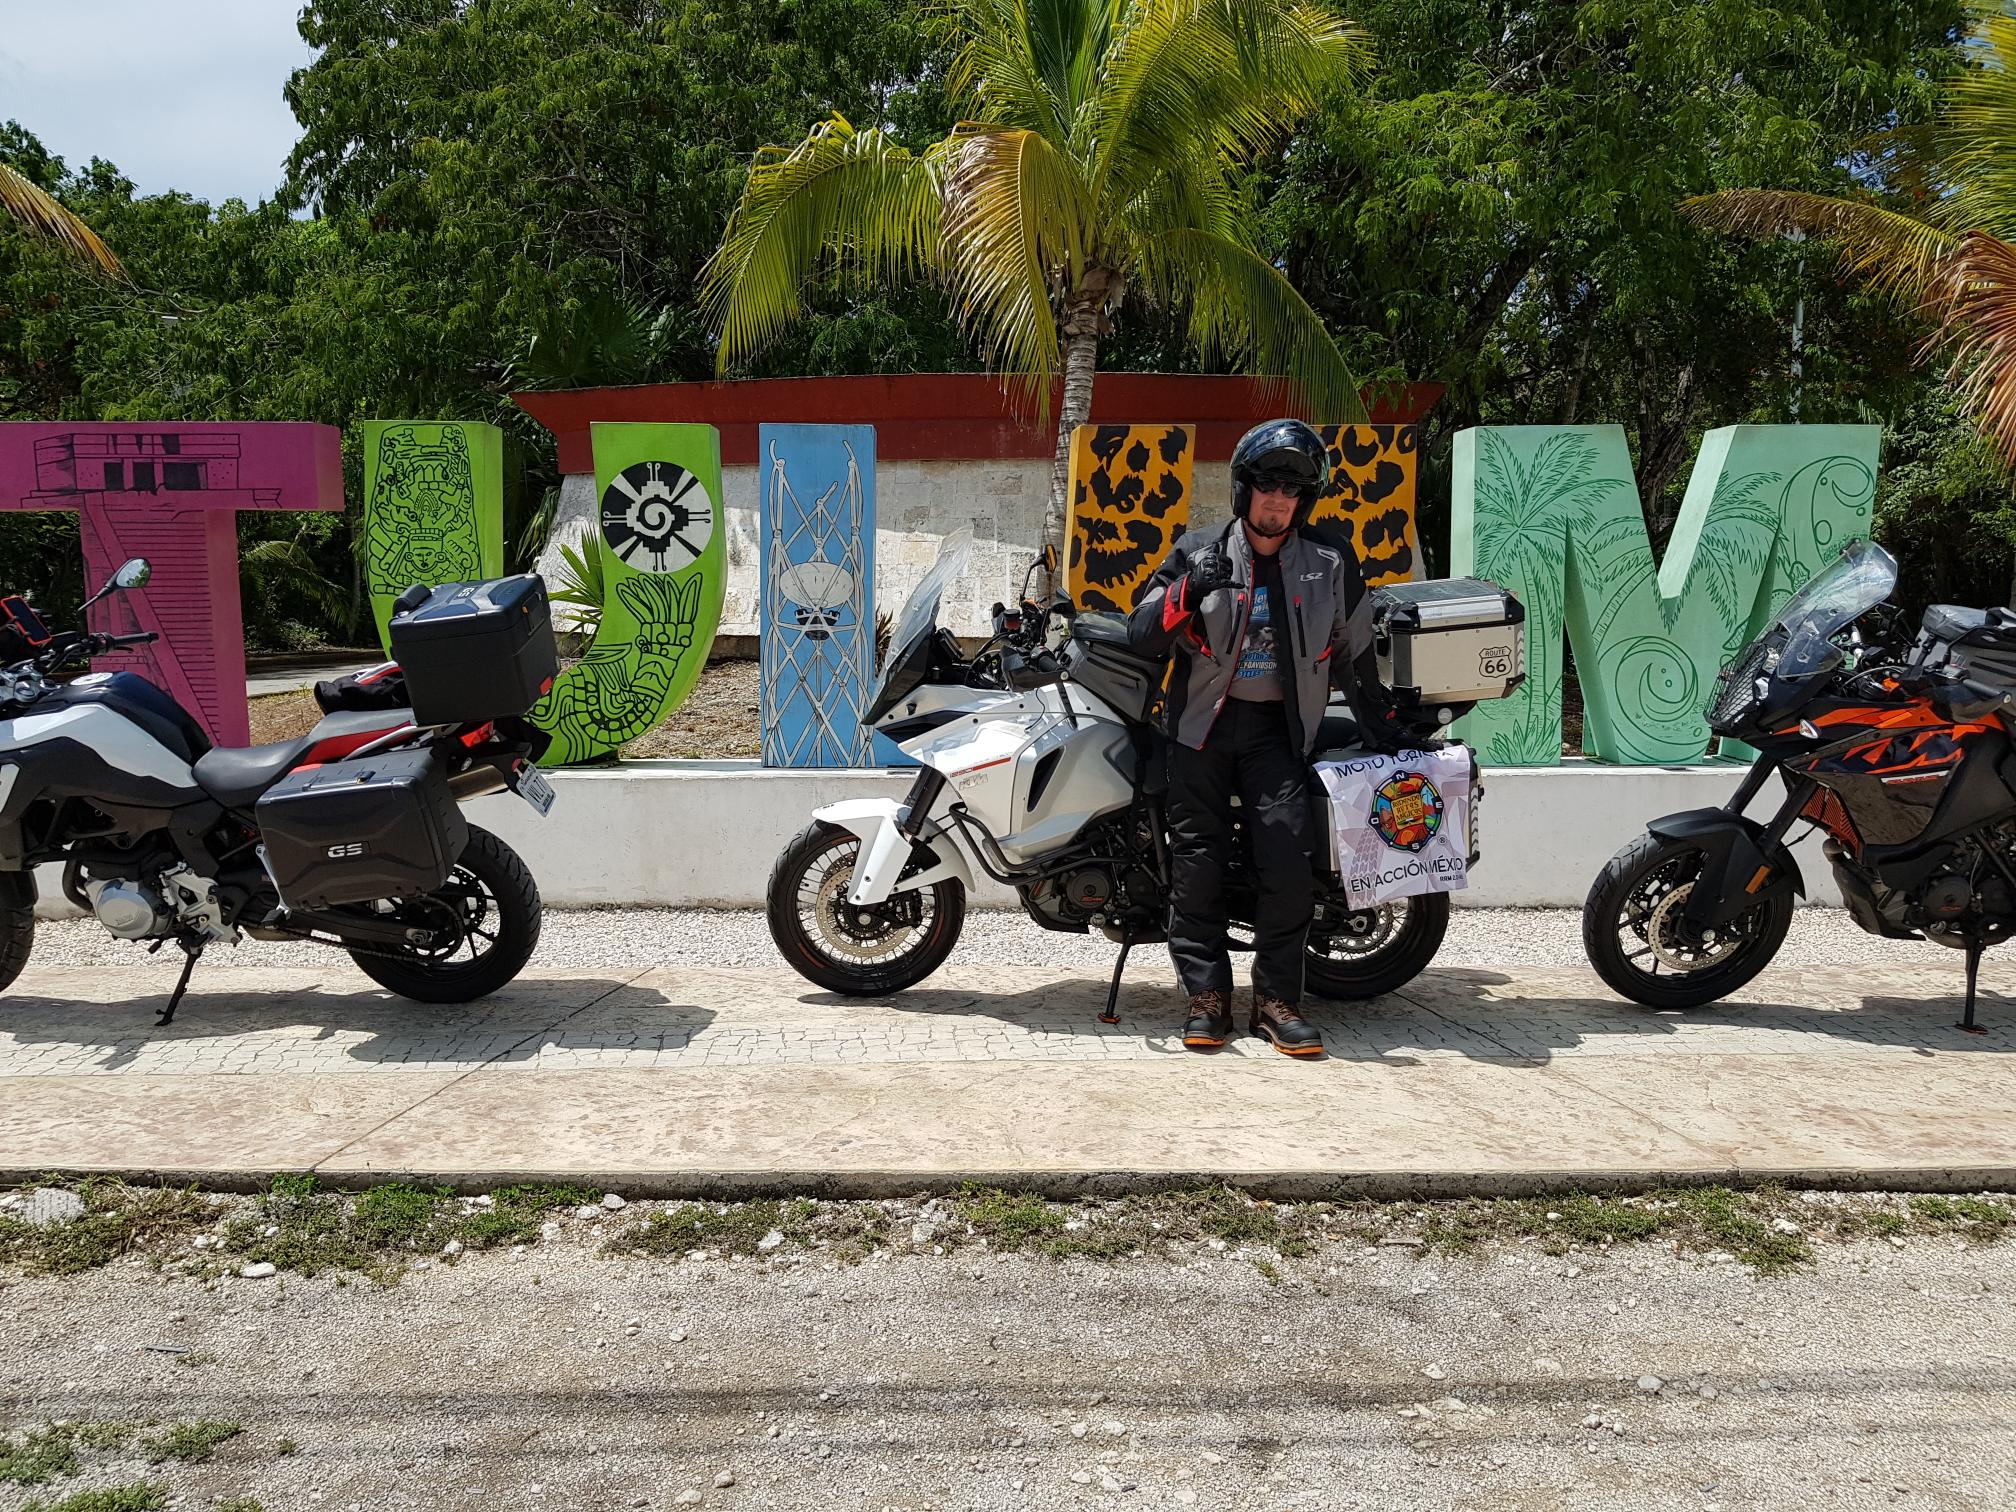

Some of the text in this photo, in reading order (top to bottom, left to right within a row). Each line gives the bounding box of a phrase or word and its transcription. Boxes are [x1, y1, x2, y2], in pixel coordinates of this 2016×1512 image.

[1485, 659, 1506, 674] 66
[1336, 758, 1384, 778] MOTO
[1395, 772, 1405, 780] N
[327, 842, 363, 858] GS
[1351, 877, 1370, 893] EN
[1374, 859, 1428, 888] ACCIÓN
